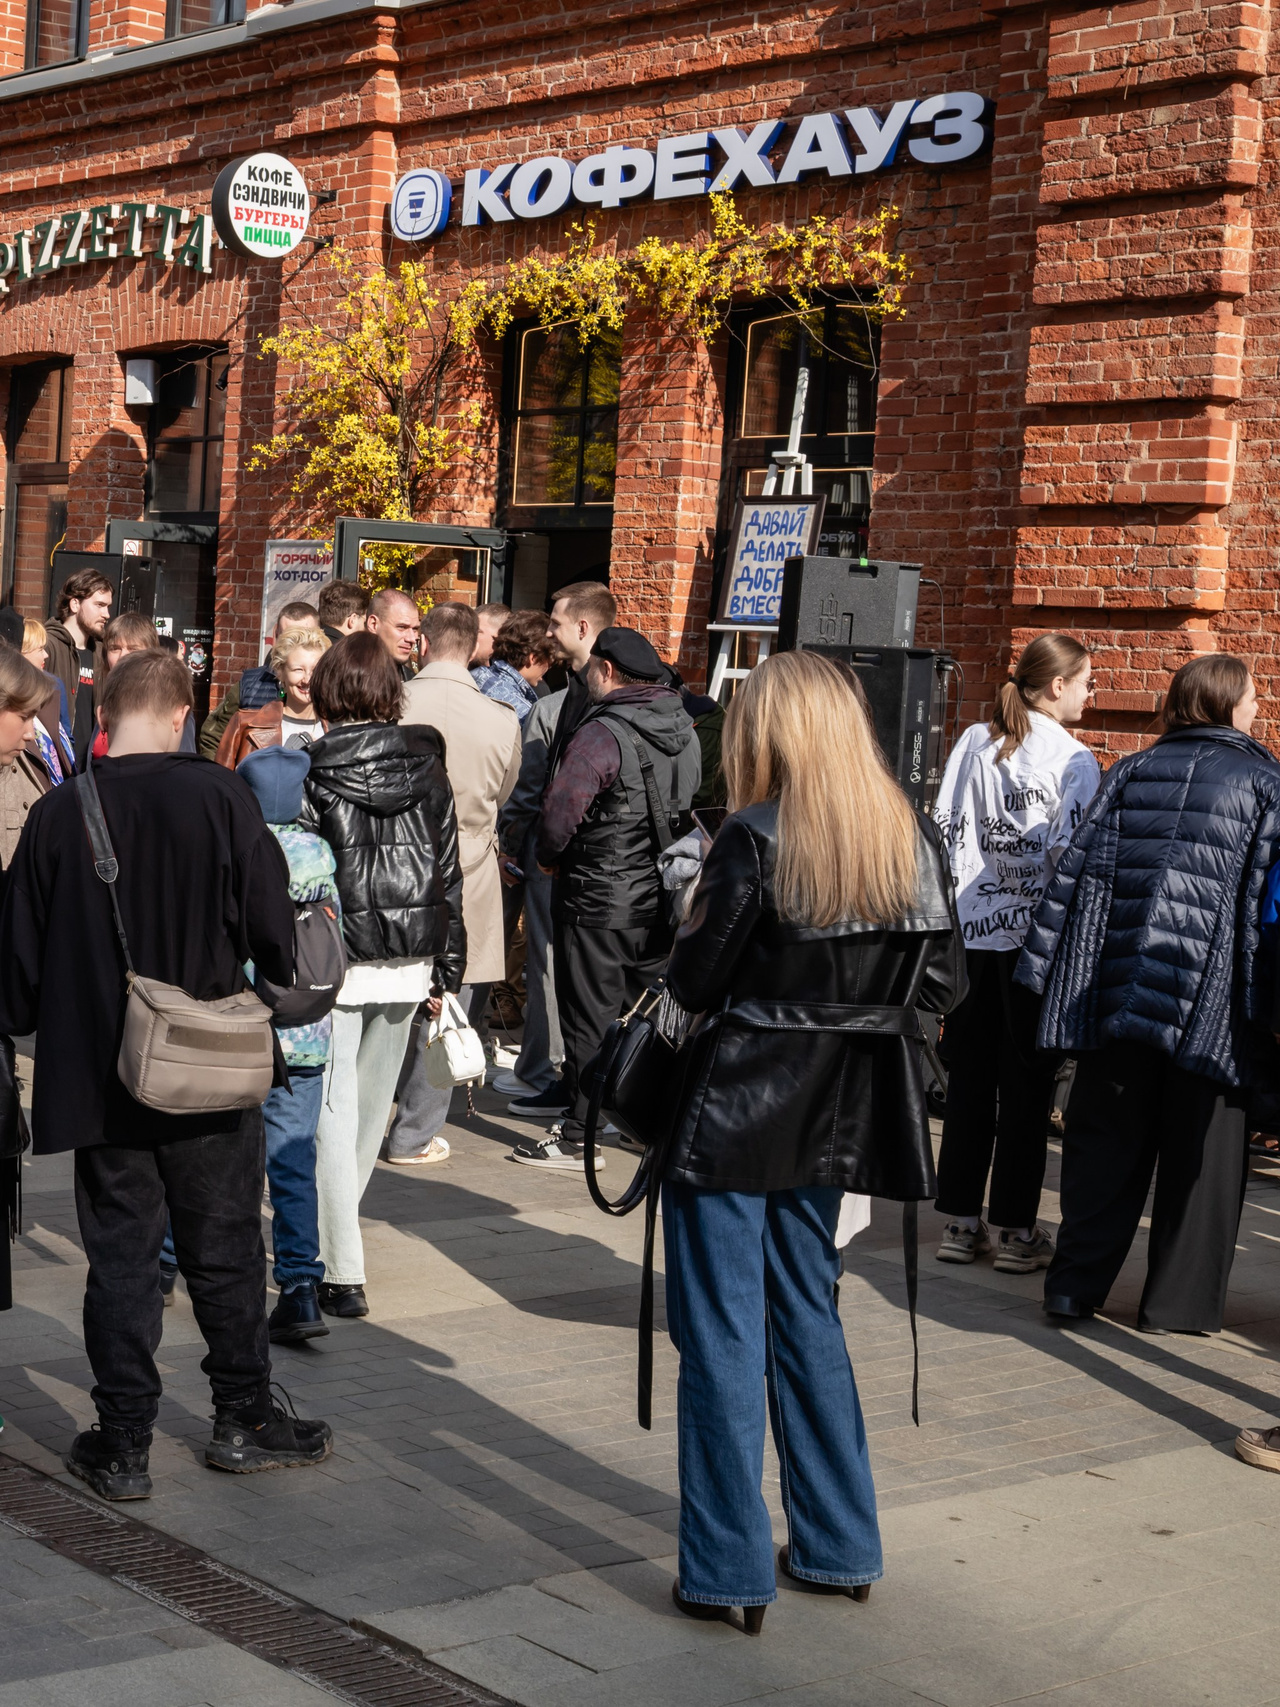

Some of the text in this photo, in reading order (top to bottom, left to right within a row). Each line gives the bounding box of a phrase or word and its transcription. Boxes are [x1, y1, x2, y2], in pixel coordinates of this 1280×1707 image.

[462, 91, 987, 226] КОФЕХАУЗ
[247, 165, 293, 188] КОФЕ
[232, 182, 306, 211] СЭНДВИЧИ
[233, 206, 305, 230] БУРГЕРЫ
[243, 226, 292, 249] ПИЦЦА
[744, 505, 809, 538] ДАВАЙ
[819, 530, 856, 543] ОБУЙ
[739, 539, 803, 562] ДЕЛАТЬ
[273, 570, 328, 583] ХОТ-ДОГ
[733, 565, 784, 593] ДОБР
[977, 878, 1042, 897] Shockin
